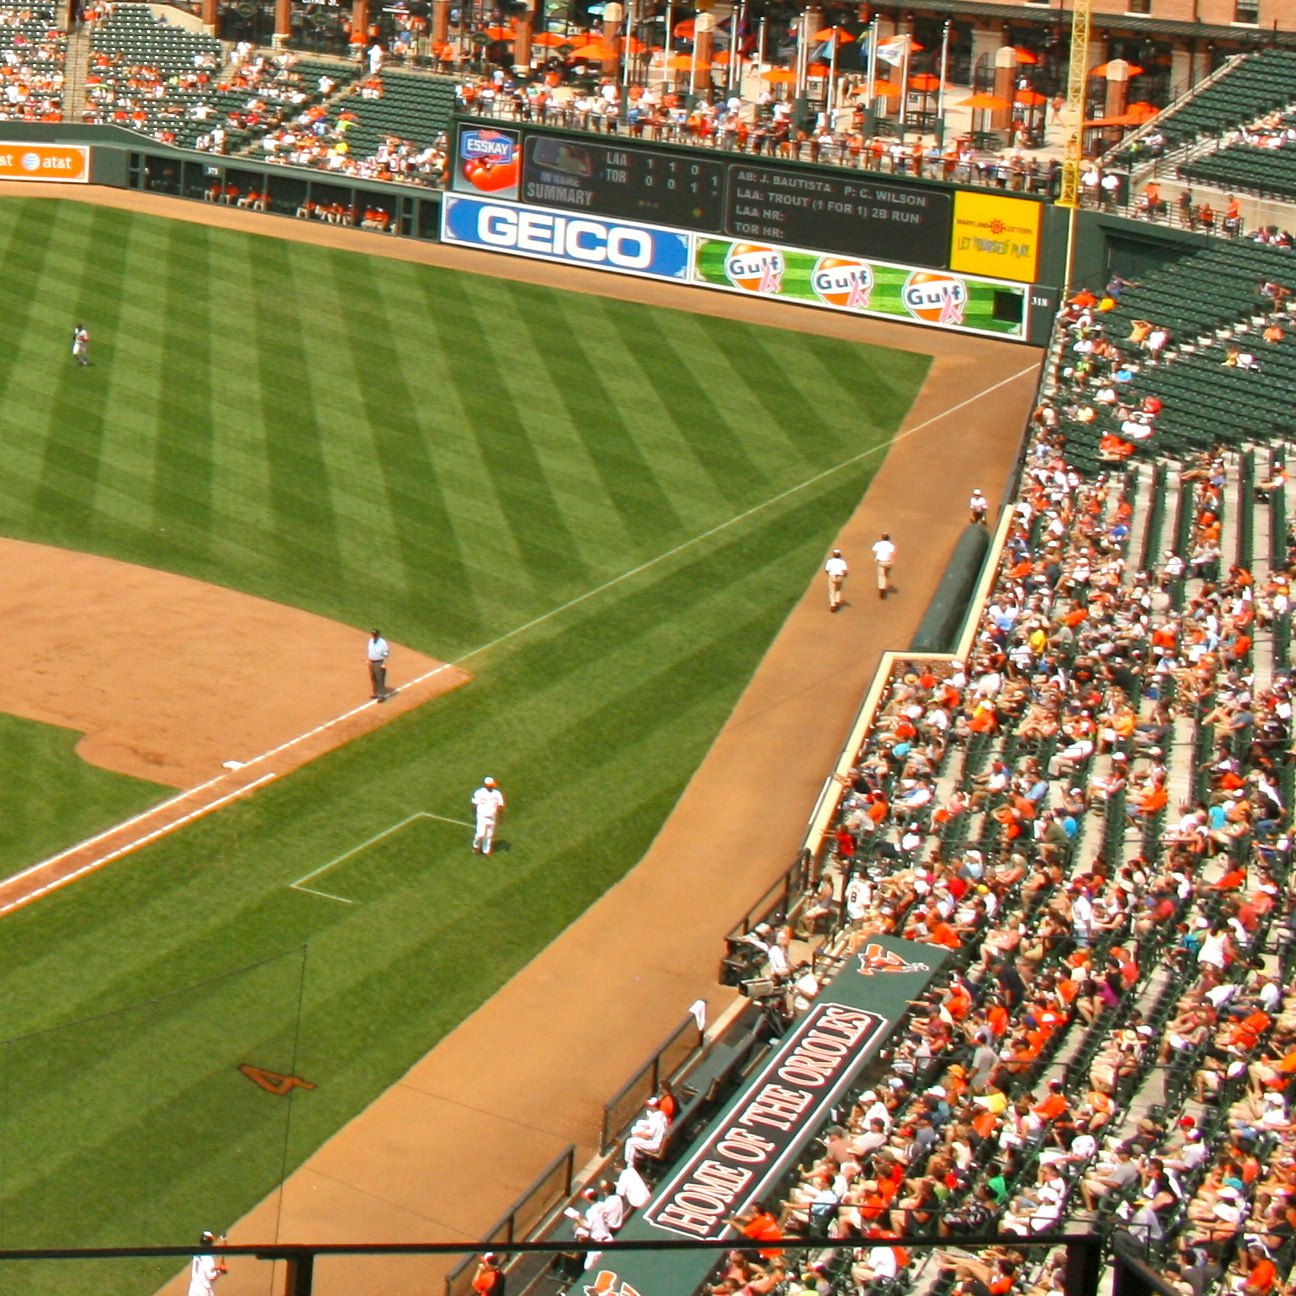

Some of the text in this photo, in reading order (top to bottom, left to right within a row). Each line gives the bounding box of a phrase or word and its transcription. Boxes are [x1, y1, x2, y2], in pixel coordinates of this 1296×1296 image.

[466, 138, 509, 155] ESSKAY
[42, 156, 72, 170] at&t
[605, 151, 699, 176] LAA 1 1 0
[606, 167, 698, 193] TOR 0 0 1
[737, 170, 926, 207] AB: J. BAUTISTA P: C. WILSON
[527, 181, 593, 205] SUMMARY
[736, 205, 784, 222] LAA HR:
[737, 188, 920, 224] LAA: TROUT (1 FOR 1) 2B RUN
[477, 205, 654, 269] GEICO
[735, 222, 784, 239] TOR HR:
[728, 253, 962, 306] Gulf Gulf Gulf
[1031, 296, 1049, 308] 318
[657, 1007, 872, 1235] HOME OF THE ORIOLES
